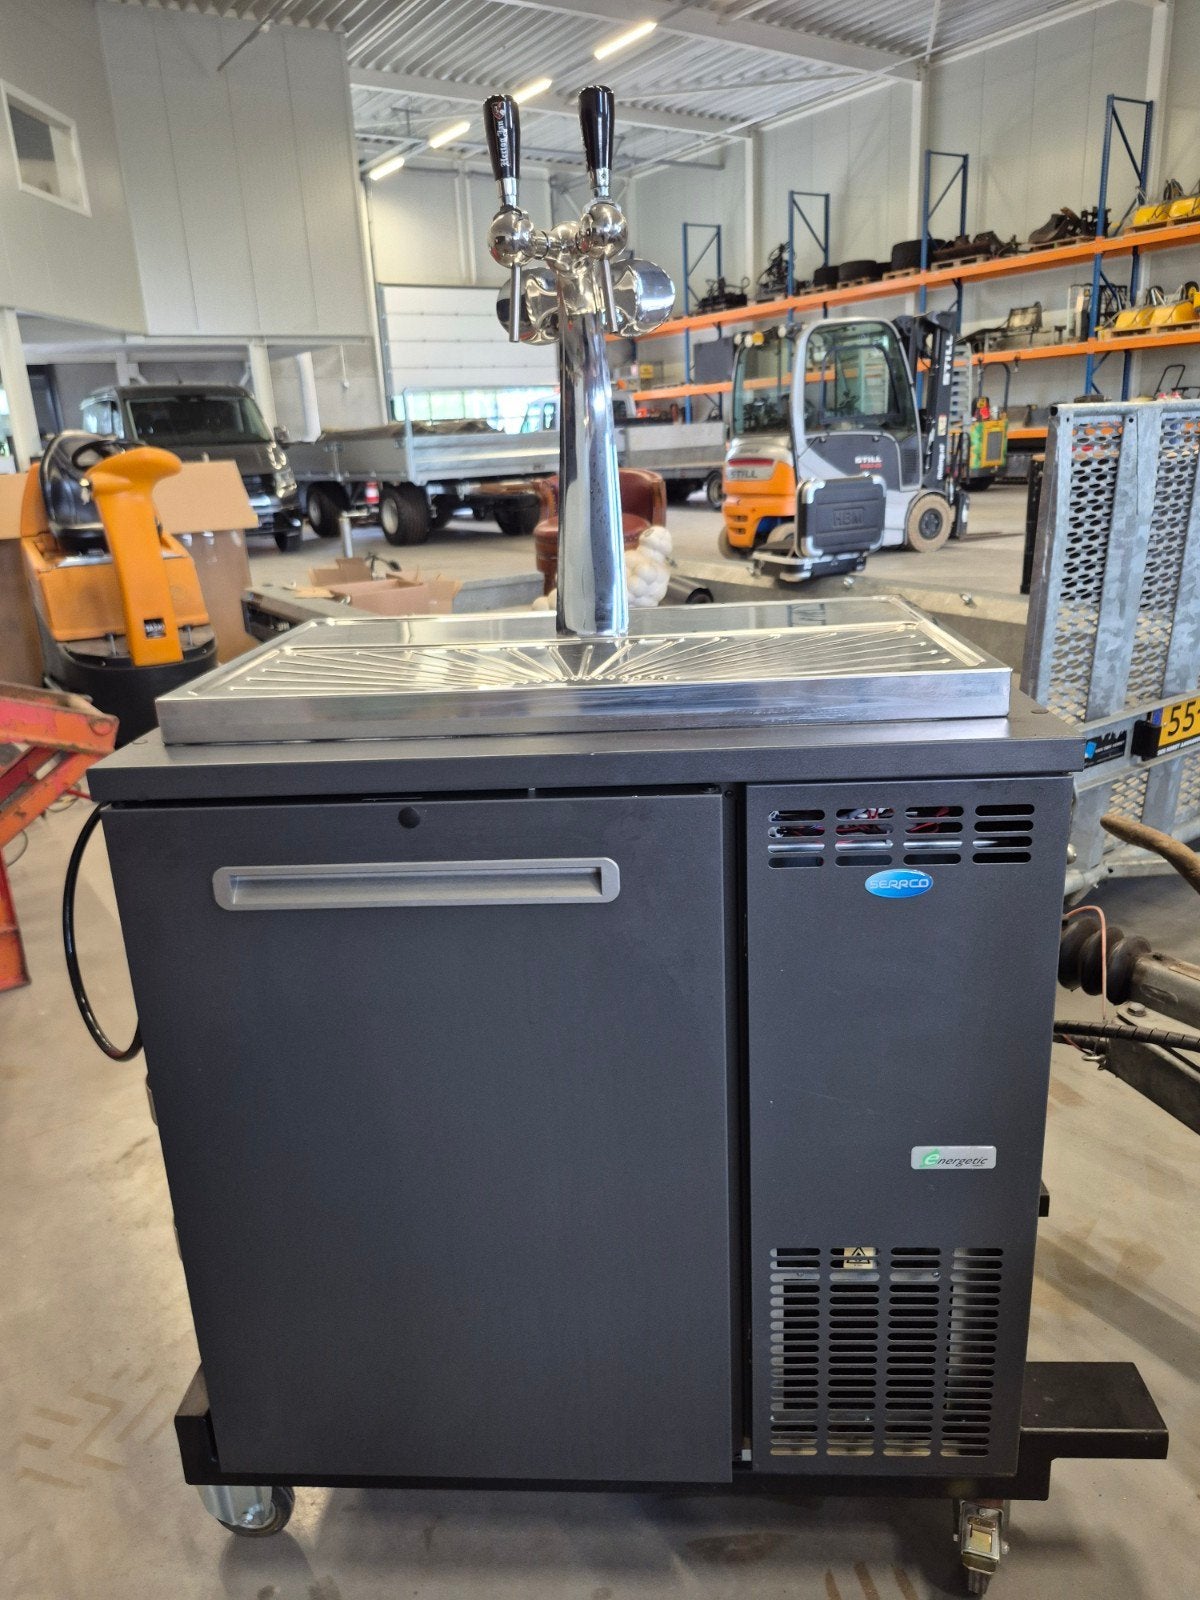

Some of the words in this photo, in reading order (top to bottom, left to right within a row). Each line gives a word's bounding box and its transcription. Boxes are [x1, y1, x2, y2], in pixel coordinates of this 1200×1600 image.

[497, 120, 508, 138] Jan
[499, 138, 510, 167] Hertog
[942, 334, 954, 386] STILL
[854, 455, 882, 464] STILL
[730, 469, 758, 479] STILL
[834, 510, 863, 524] HBM
[870, 879, 929, 889] SERRCO
